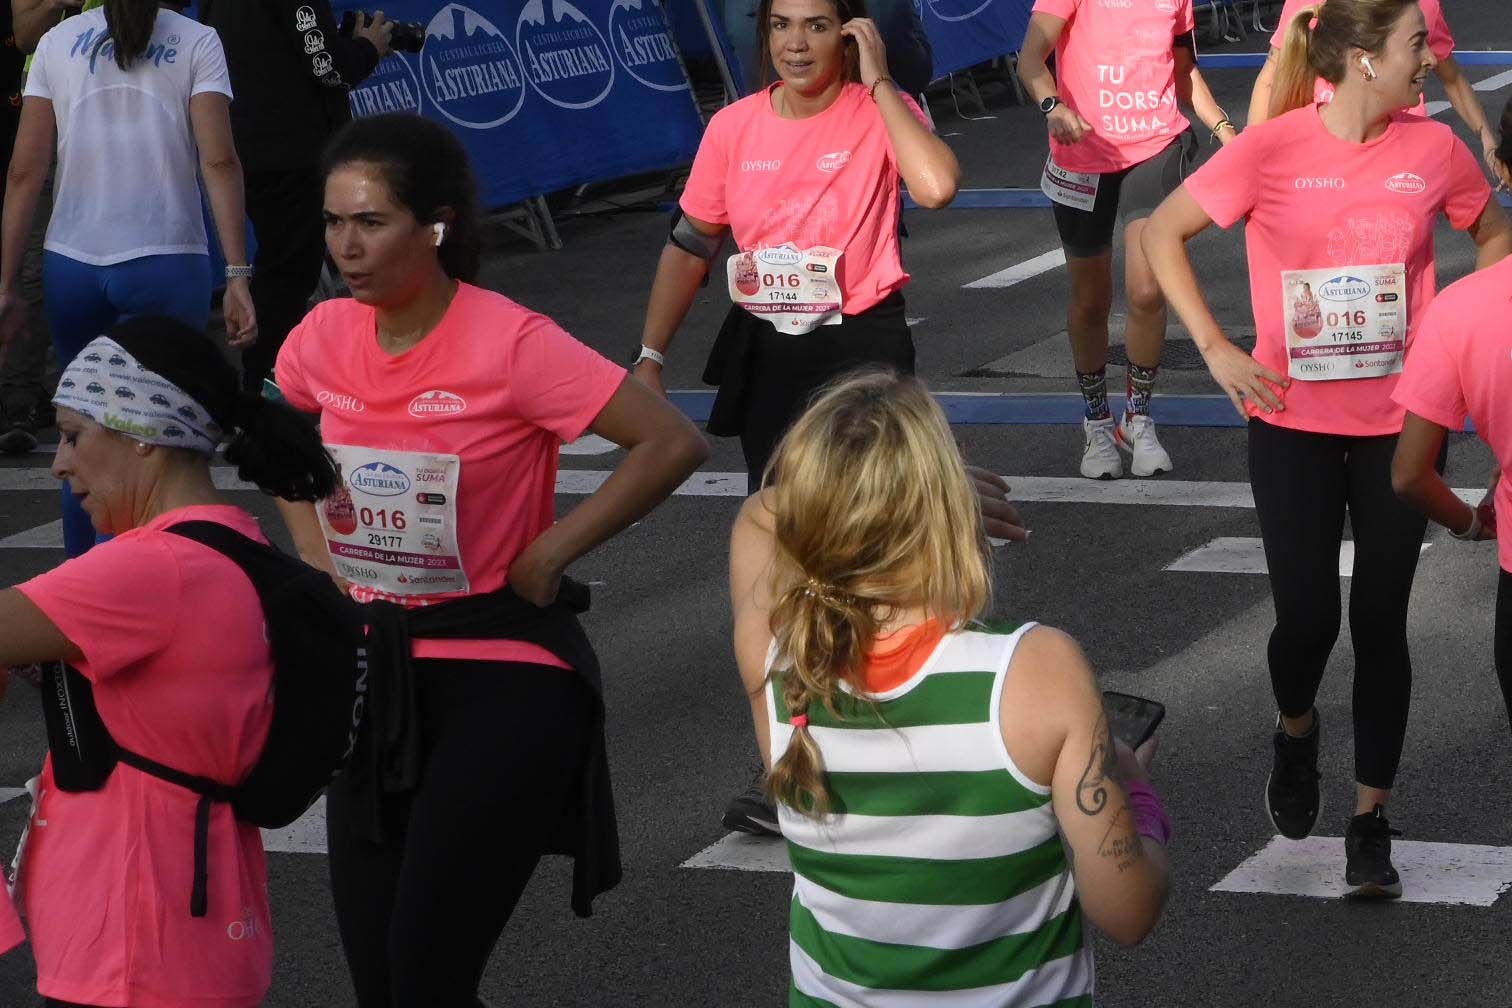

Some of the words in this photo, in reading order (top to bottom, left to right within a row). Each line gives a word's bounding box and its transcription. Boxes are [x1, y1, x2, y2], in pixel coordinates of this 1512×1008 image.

[621, 24, 680, 68] ASTUR
[528, 43, 611, 84] ASTURIANA
[432, 55, 521, 103] ASTURIANA
[1096, 64, 1124, 84] TU
[741, 159, 781, 172] OYSHO
[1295, 177, 1345, 190] OYSHO
[762, 273, 800, 288] 016
[769, 292, 797, 301] 17144
[1324, 286, 1367, 297] ASTURIANA
[1327, 310, 1366, 327] 016
[1331, 331, 1363, 342] 17145
[1300, 362, 1335, 373] OYSHO
[316, 390, 364, 412] OYSHO
[412, 401, 461, 412] ASTURIANA
[355, 472, 406, 491] ASTURIANA
[416, 473, 446, 483] SUMA
[360, 507, 407, 531] 016
[367, 532, 403, 549] 29177
[339, 546, 374, 560] CARRERA
[374, 551, 385, 562] DE
[385, 552, 396, 563] LA
[397, 554, 425, 567] MUJER
[409, 575, 456, 585] Santander
